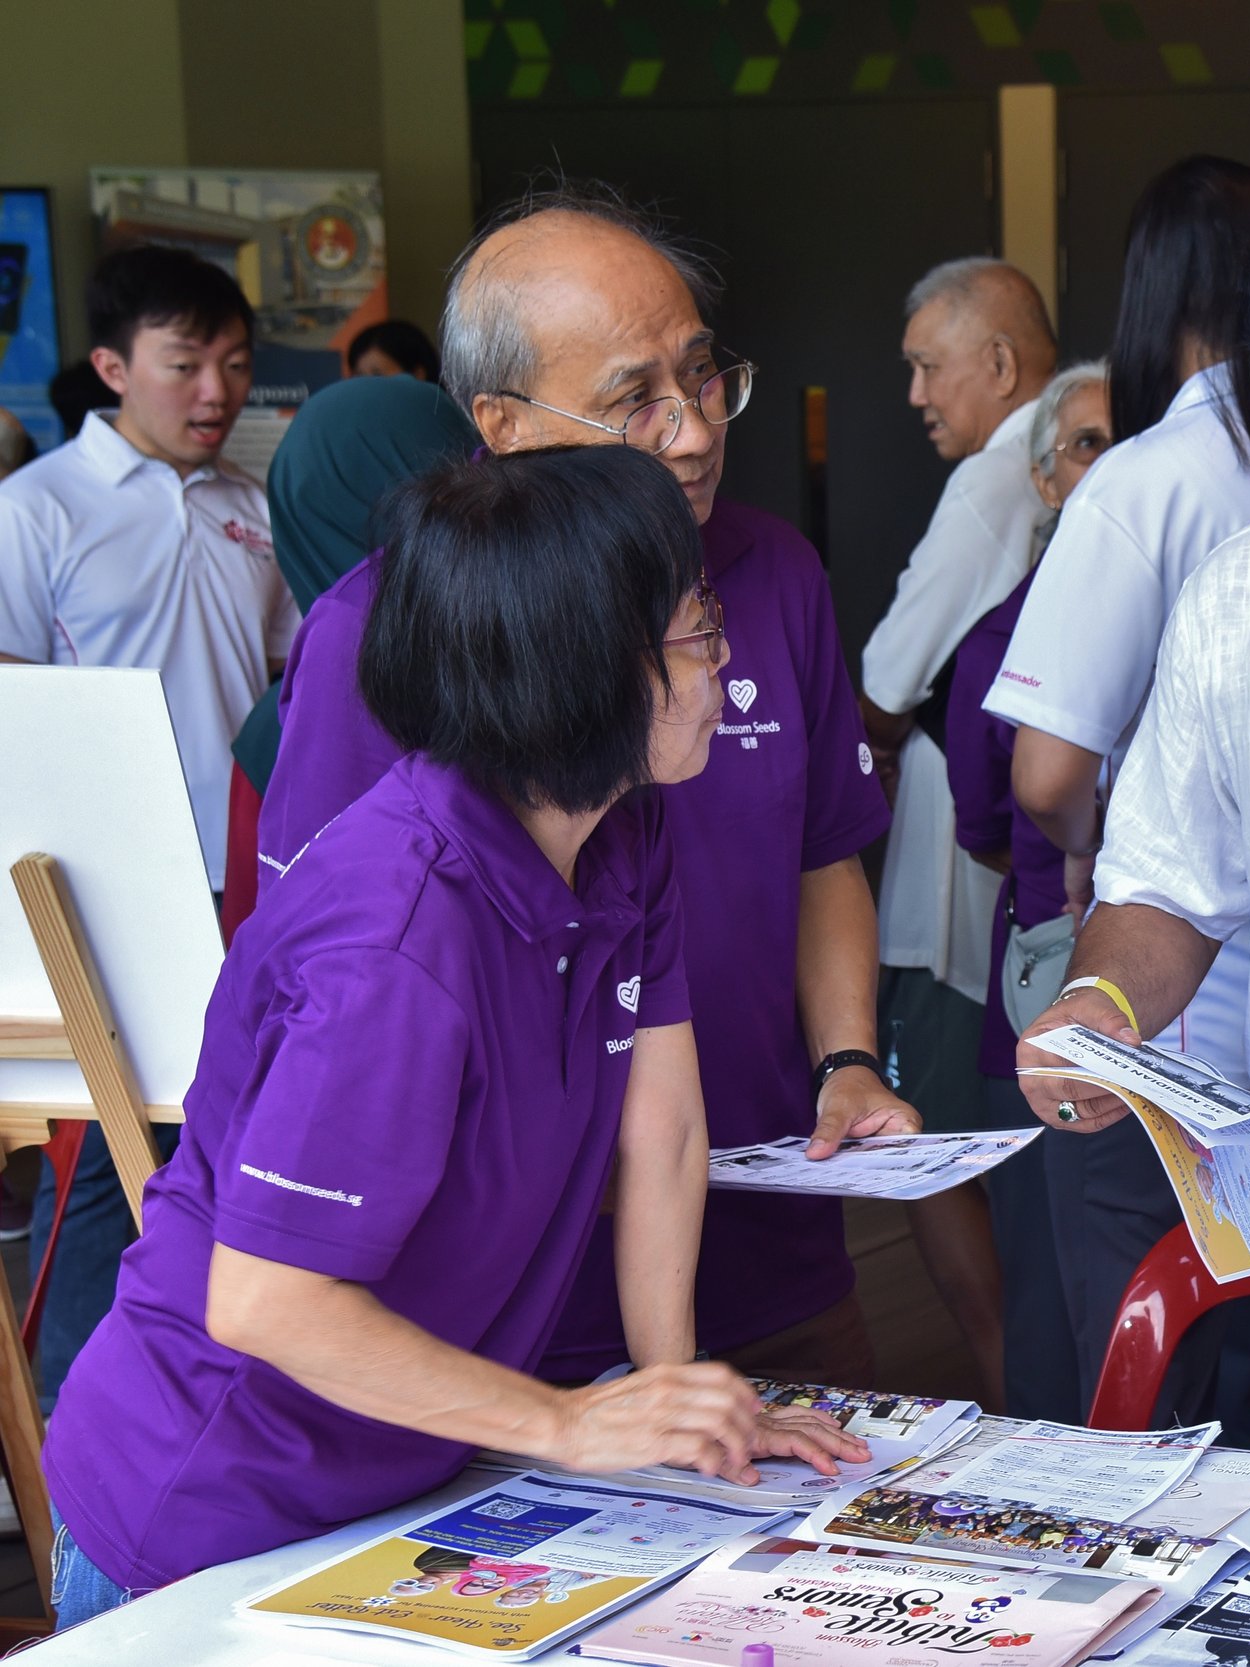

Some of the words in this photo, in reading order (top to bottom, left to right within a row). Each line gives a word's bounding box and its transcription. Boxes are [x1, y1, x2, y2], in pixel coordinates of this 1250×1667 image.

[717, 722, 752, 736] Blossom
[753, 720, 781, 734] Seeds
[1066, 1036, 1132, 1069] EXERCISE
[1128, 1066, 1202, 1105] MERIDIAN
[851, 1562, 922, 1576] Seniors
[787, 1577, 852, 1591] Cohesion
[920, 1569, 995, 1585] Tribute
[857, 1583, 902, 1595] Social
[305, 1603, 370, 1614] Better
[762, 1585, 945, 1618] Seniors
[371, 1608, 414, 1619] Eat
[938, 1612, 956, 1621] to
[428, 1614, 484, 1629] Hear
[815, 1633, 883, 1648] Blossom
[824, 1614, 1015, 1655] Tribute
